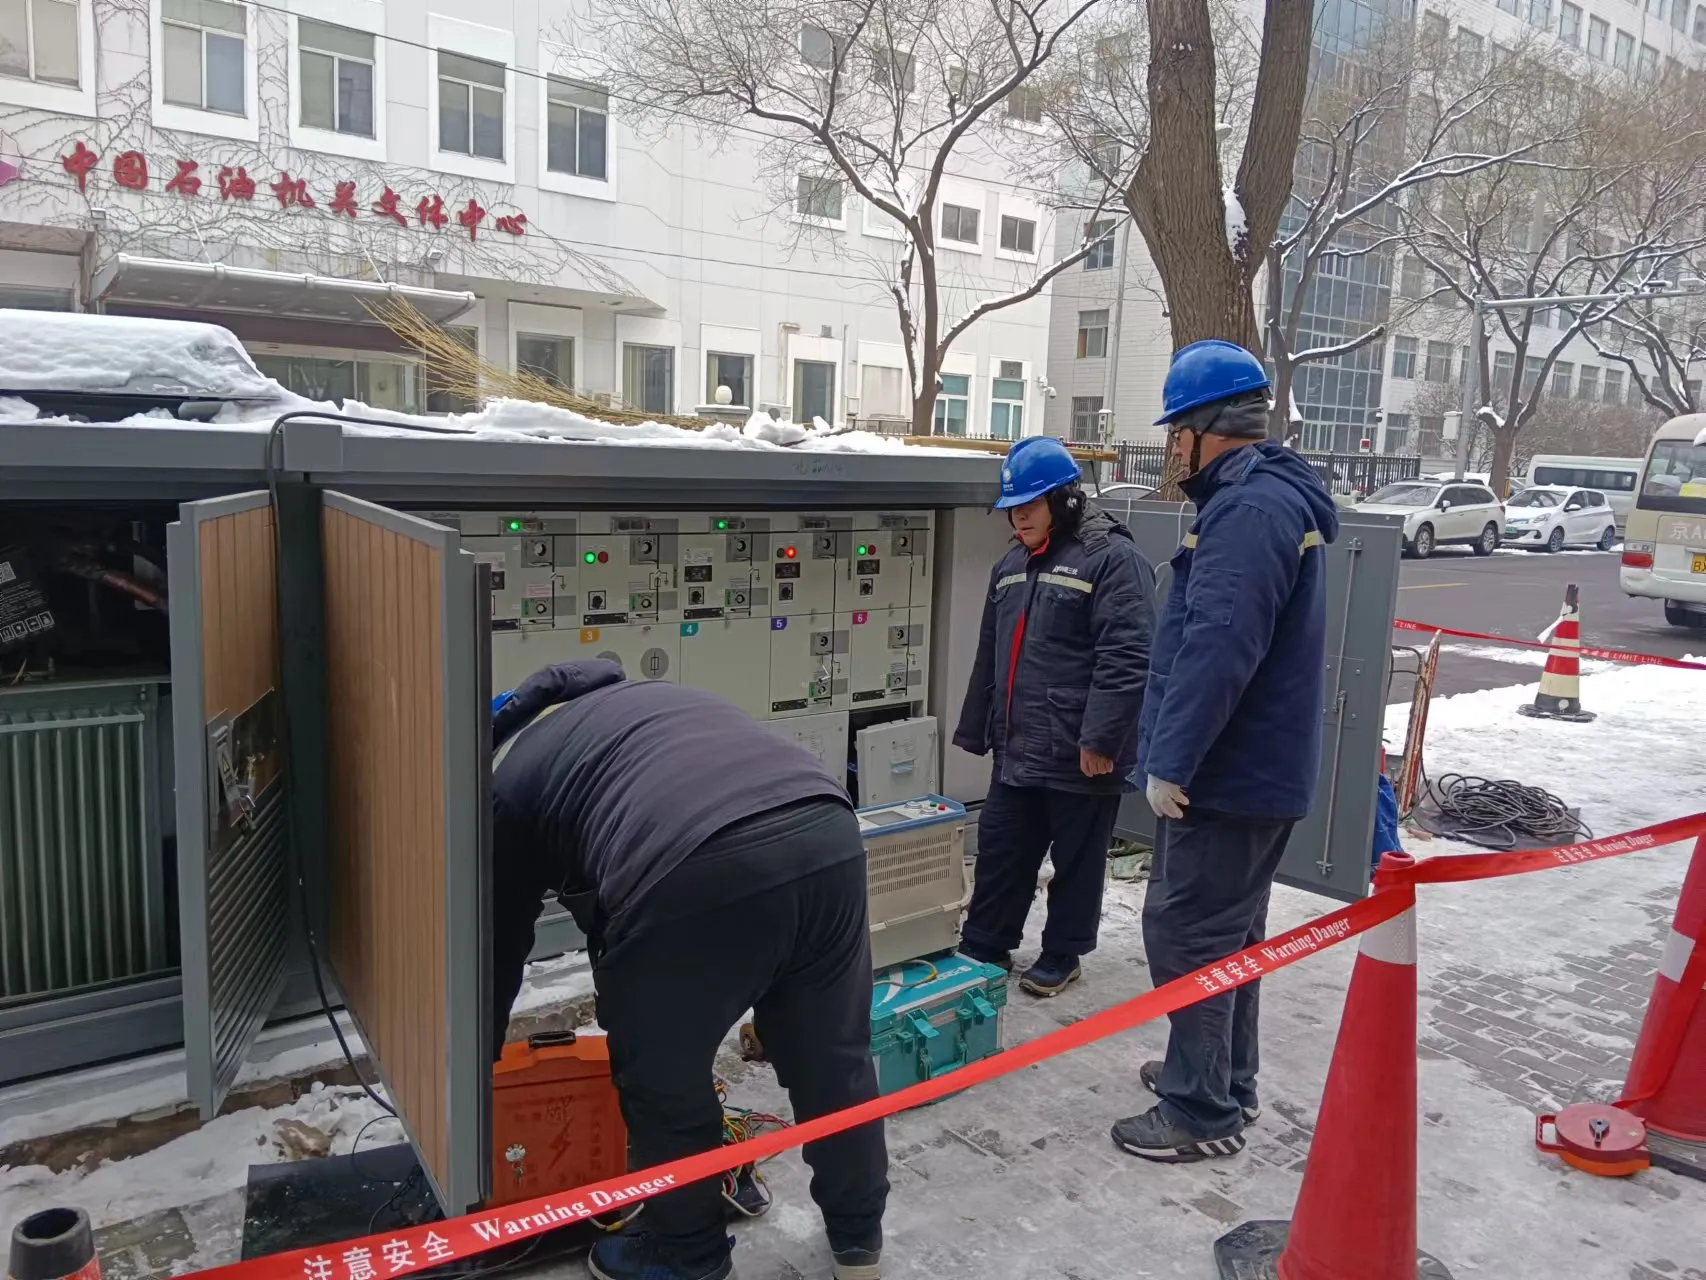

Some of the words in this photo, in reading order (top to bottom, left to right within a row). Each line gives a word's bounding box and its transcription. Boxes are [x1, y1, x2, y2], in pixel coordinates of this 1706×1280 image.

[61, 140, 527, 242] 中国石油机关文体中心
[1670, 521, 1706, 540] 京A
[1612, 652, 1637, 663] LIMIT
[1641, 655, 1663, 665] LINE
[1195, 954, 1263, 993] 注意安全
[1261, 933, 1318, 962] Warning
[1310, 917, 1351, 944] Danger
[303, 1230, 455, 1280] 注意安全
[471, 1205, 592, 1242] Warning
[588, 1174, 677, 1208] Danger
